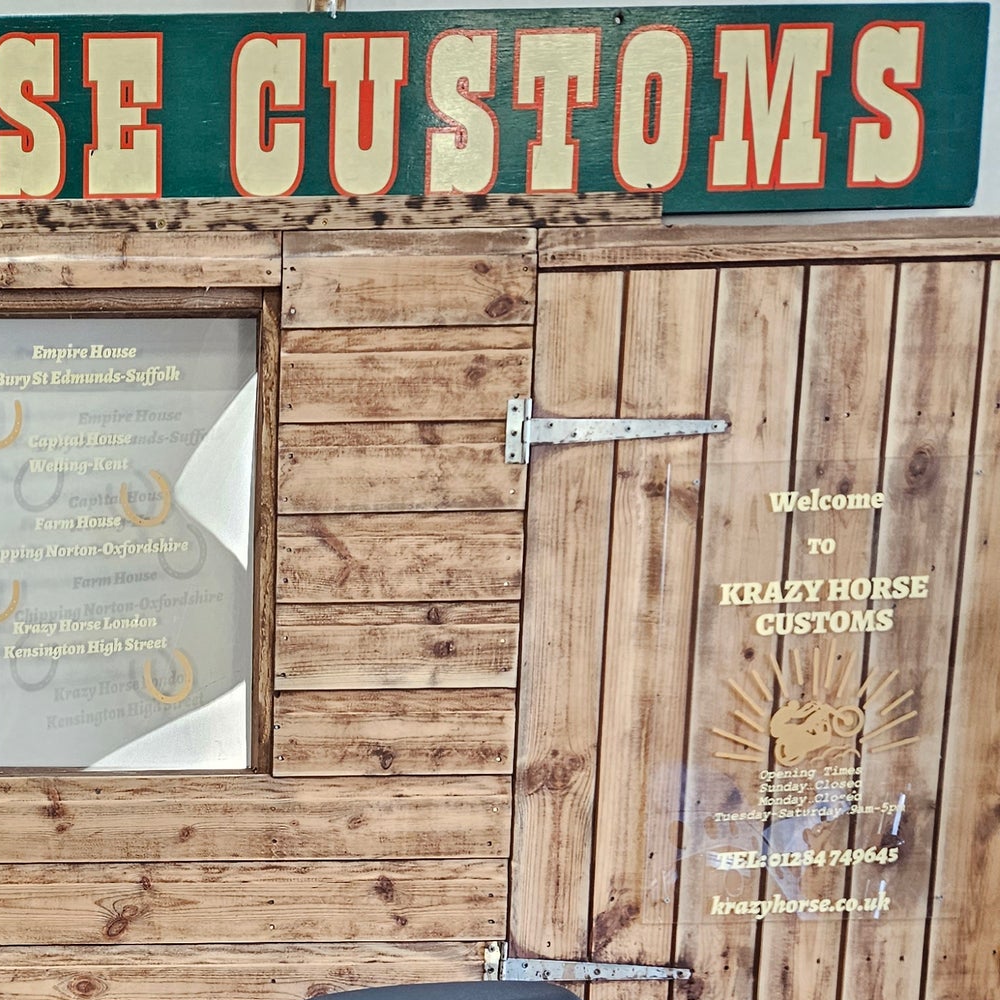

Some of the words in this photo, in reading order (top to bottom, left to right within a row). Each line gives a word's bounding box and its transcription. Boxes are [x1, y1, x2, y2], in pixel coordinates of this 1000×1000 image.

[230, 20, 925, 197] CUSTOMS
[32, 344, 88, 363] Empire
[90, 344, 137, 359] House
[32, 371, 48, 385] St
[50, 366, 180, 386] Edmunds-Suffolk
[28, 433, 85, 450] Capital
[87, 432, 131, 446] House
[29, 457, 129, 475] Welling-Kent
[769, 488, 885, 512] Welcome
[35, 517, 75, 530] Farm
[76, 516, 121, 529] House
[45, 538, 189, 559] Norton-Oxfordshire
[807, 538, 836, 555] TO
[719, 579, 825, 605] KRAZY
[827, 575, 929, 602] HORSE
[12, 621, 57, 636] Krazy
[59, 618, 101, 632] Horse
[102, 614, 158, 629] London
[755, 609, 894, 636] CUSTOMS
[4, 643, 85, 660] Kensington
[87, 640, 123, 656] High
[124, 636, 167, 651] Street
[760, 767, 817, 782] Opening
[823, 765, 862, 776] Times
[716, 851, 768, 870] TEL:
[769, 849, 827, 868] 01284
[829, 846, 899, 866] 749645
[711, 891, 891, 920] krazyhorse.co.uk
